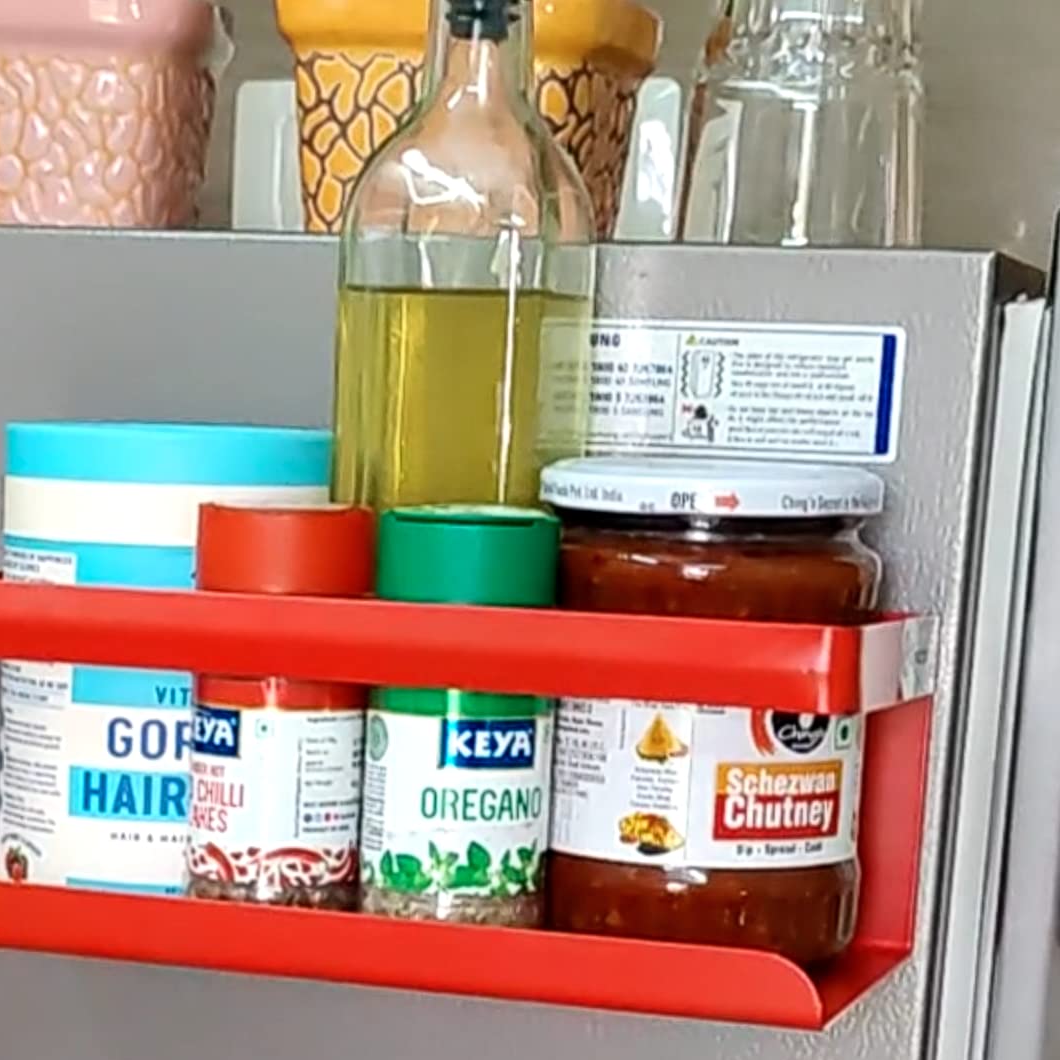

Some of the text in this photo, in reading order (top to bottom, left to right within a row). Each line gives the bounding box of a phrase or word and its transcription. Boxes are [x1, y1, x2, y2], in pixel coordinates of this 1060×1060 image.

[671, 491, 697, 510] OPE
[449, 728, 532, 759] KEYA
[82, 770, 188, 817] HAIR
[196, 778, 245, 808] CHILLI
[726, 767, 837, 796] Schezwan
[420, 786, 543, 822] OREGANO
[722, 795, 834, 833] Chutney
